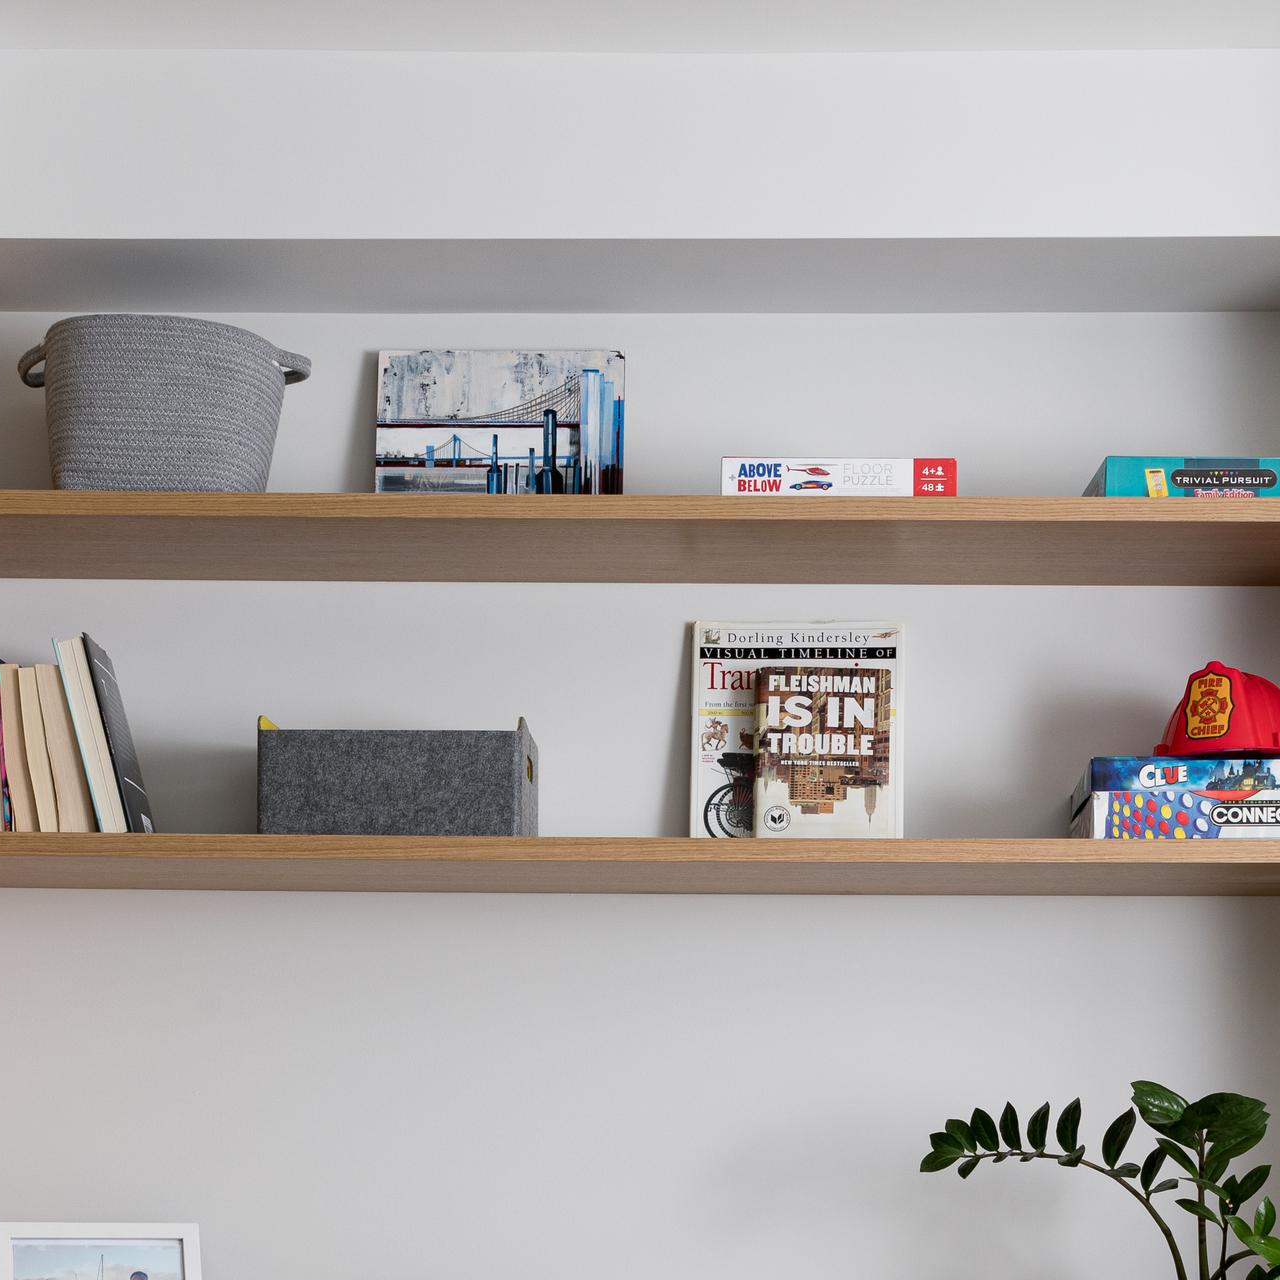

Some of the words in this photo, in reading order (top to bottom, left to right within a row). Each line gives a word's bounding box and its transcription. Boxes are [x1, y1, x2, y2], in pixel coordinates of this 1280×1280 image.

[738, 463, 782, 478] ABOVE
[843, 463, 893, 475] FLOOR
[921, 466, 936, 476] 4+
[738, 479, 782, 492] BELOW
[843, 475, 894, 486] PUZZLE
[921, 483, 935, 491] 48
[1194, 489, 1222, 497] Family
[1224, 489, 1254, 498] Edition
[728, 632, 784, 645] Dorling
[791, 632, 870, 645] Kindersley
[704, 649, 769, 659] VISUAL
[779, 649, 869, 658] TIMELINE
[876, 649, 893, 657] OF
[768, 675, 876, 693] FLEISHMAN
[1197, 678, 1223, 688] FIRE
[767, 695, 813, 728] IS
[827, 697, 875, 728] IN
[1190, 725, 1225, 736] CHIEF
[767, 732, 875, 755] TROUBLE
[1138, 764, 1188, 788] CLUE
